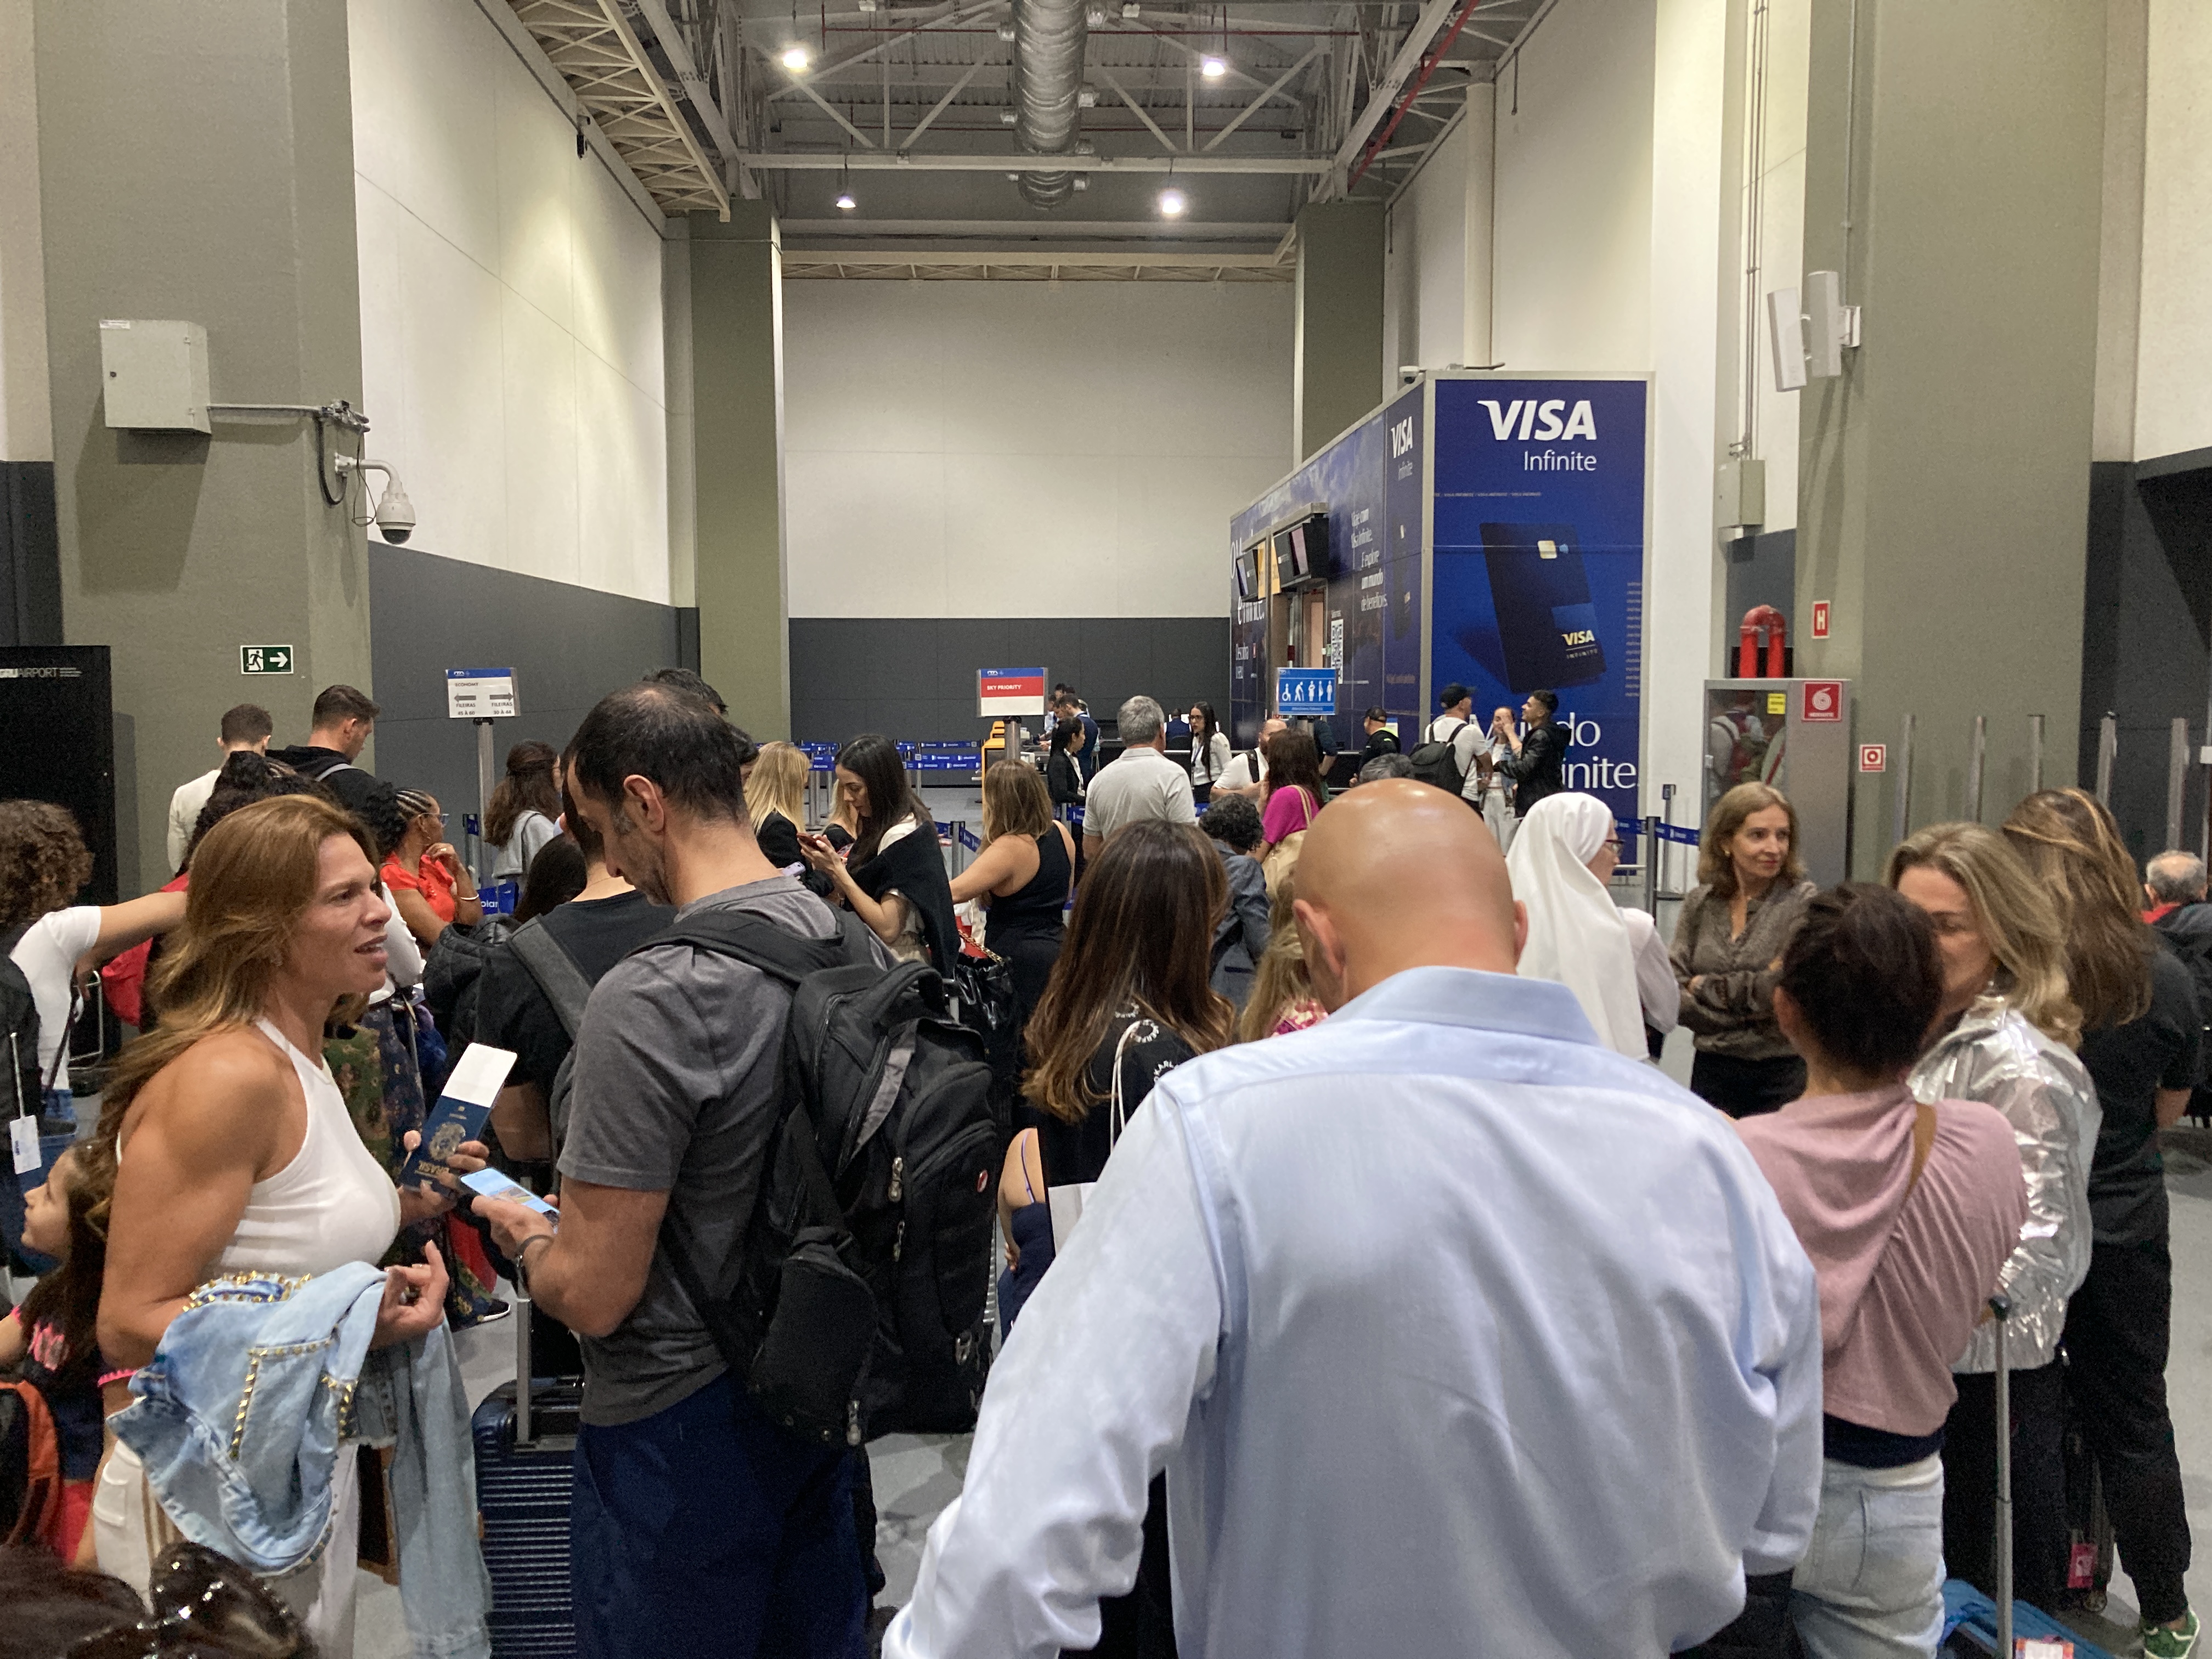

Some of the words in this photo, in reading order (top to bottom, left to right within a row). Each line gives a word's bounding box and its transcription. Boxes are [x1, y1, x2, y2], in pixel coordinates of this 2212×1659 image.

[1477, 399, 1597, 441] VISA
[1391, 416, 1413, 459] VISA
[1523, 449, 1597, 471] Infinite
[1816, 610, 1826, 630] H
[1561, 629, 1595, 646] VISA
